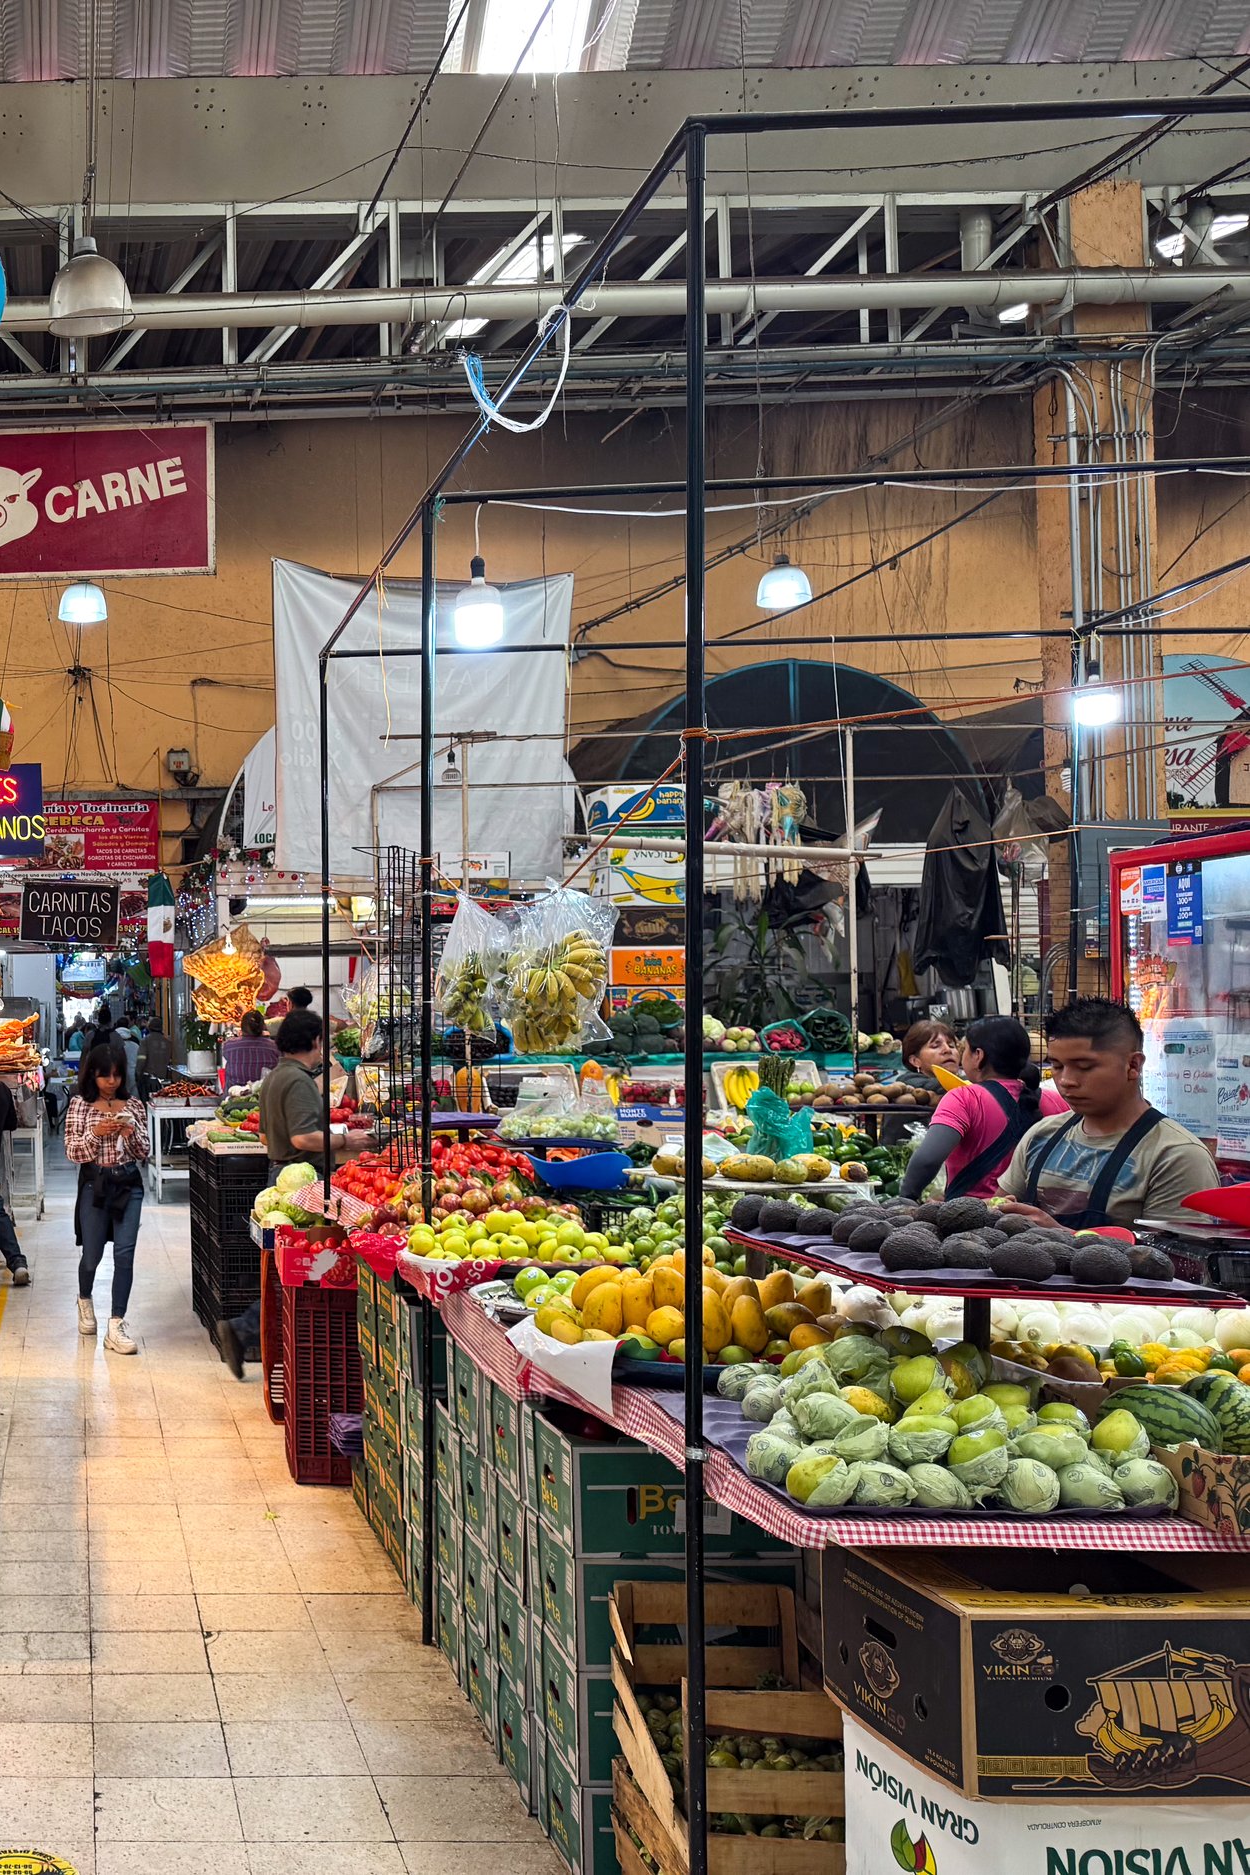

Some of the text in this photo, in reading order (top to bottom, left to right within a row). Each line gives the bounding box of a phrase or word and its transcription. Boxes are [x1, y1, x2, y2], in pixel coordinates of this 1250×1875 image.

[44, 456, 188, 524] CARNE
[659, 791, 684, 799] happy
[68, 804, 78, 815] y
[80, 802, 150, 813] Tocinería
[633, 849, 673, 859] TUCANA
[28, 891, 112, 914] CARNITAS
[37, 915, 103, 938] TACOS
[633, 965, 677, 975] BANANAS
[983, 1664, 1055, 1676] VIKINGO
[853, 1680, 906, 1730] VIKINGO
[855, 1748, 980, 1846] GRAN VISIÓN
[1027, 1819, 1102, 1831] ATMOSFERA CONTROLADA
